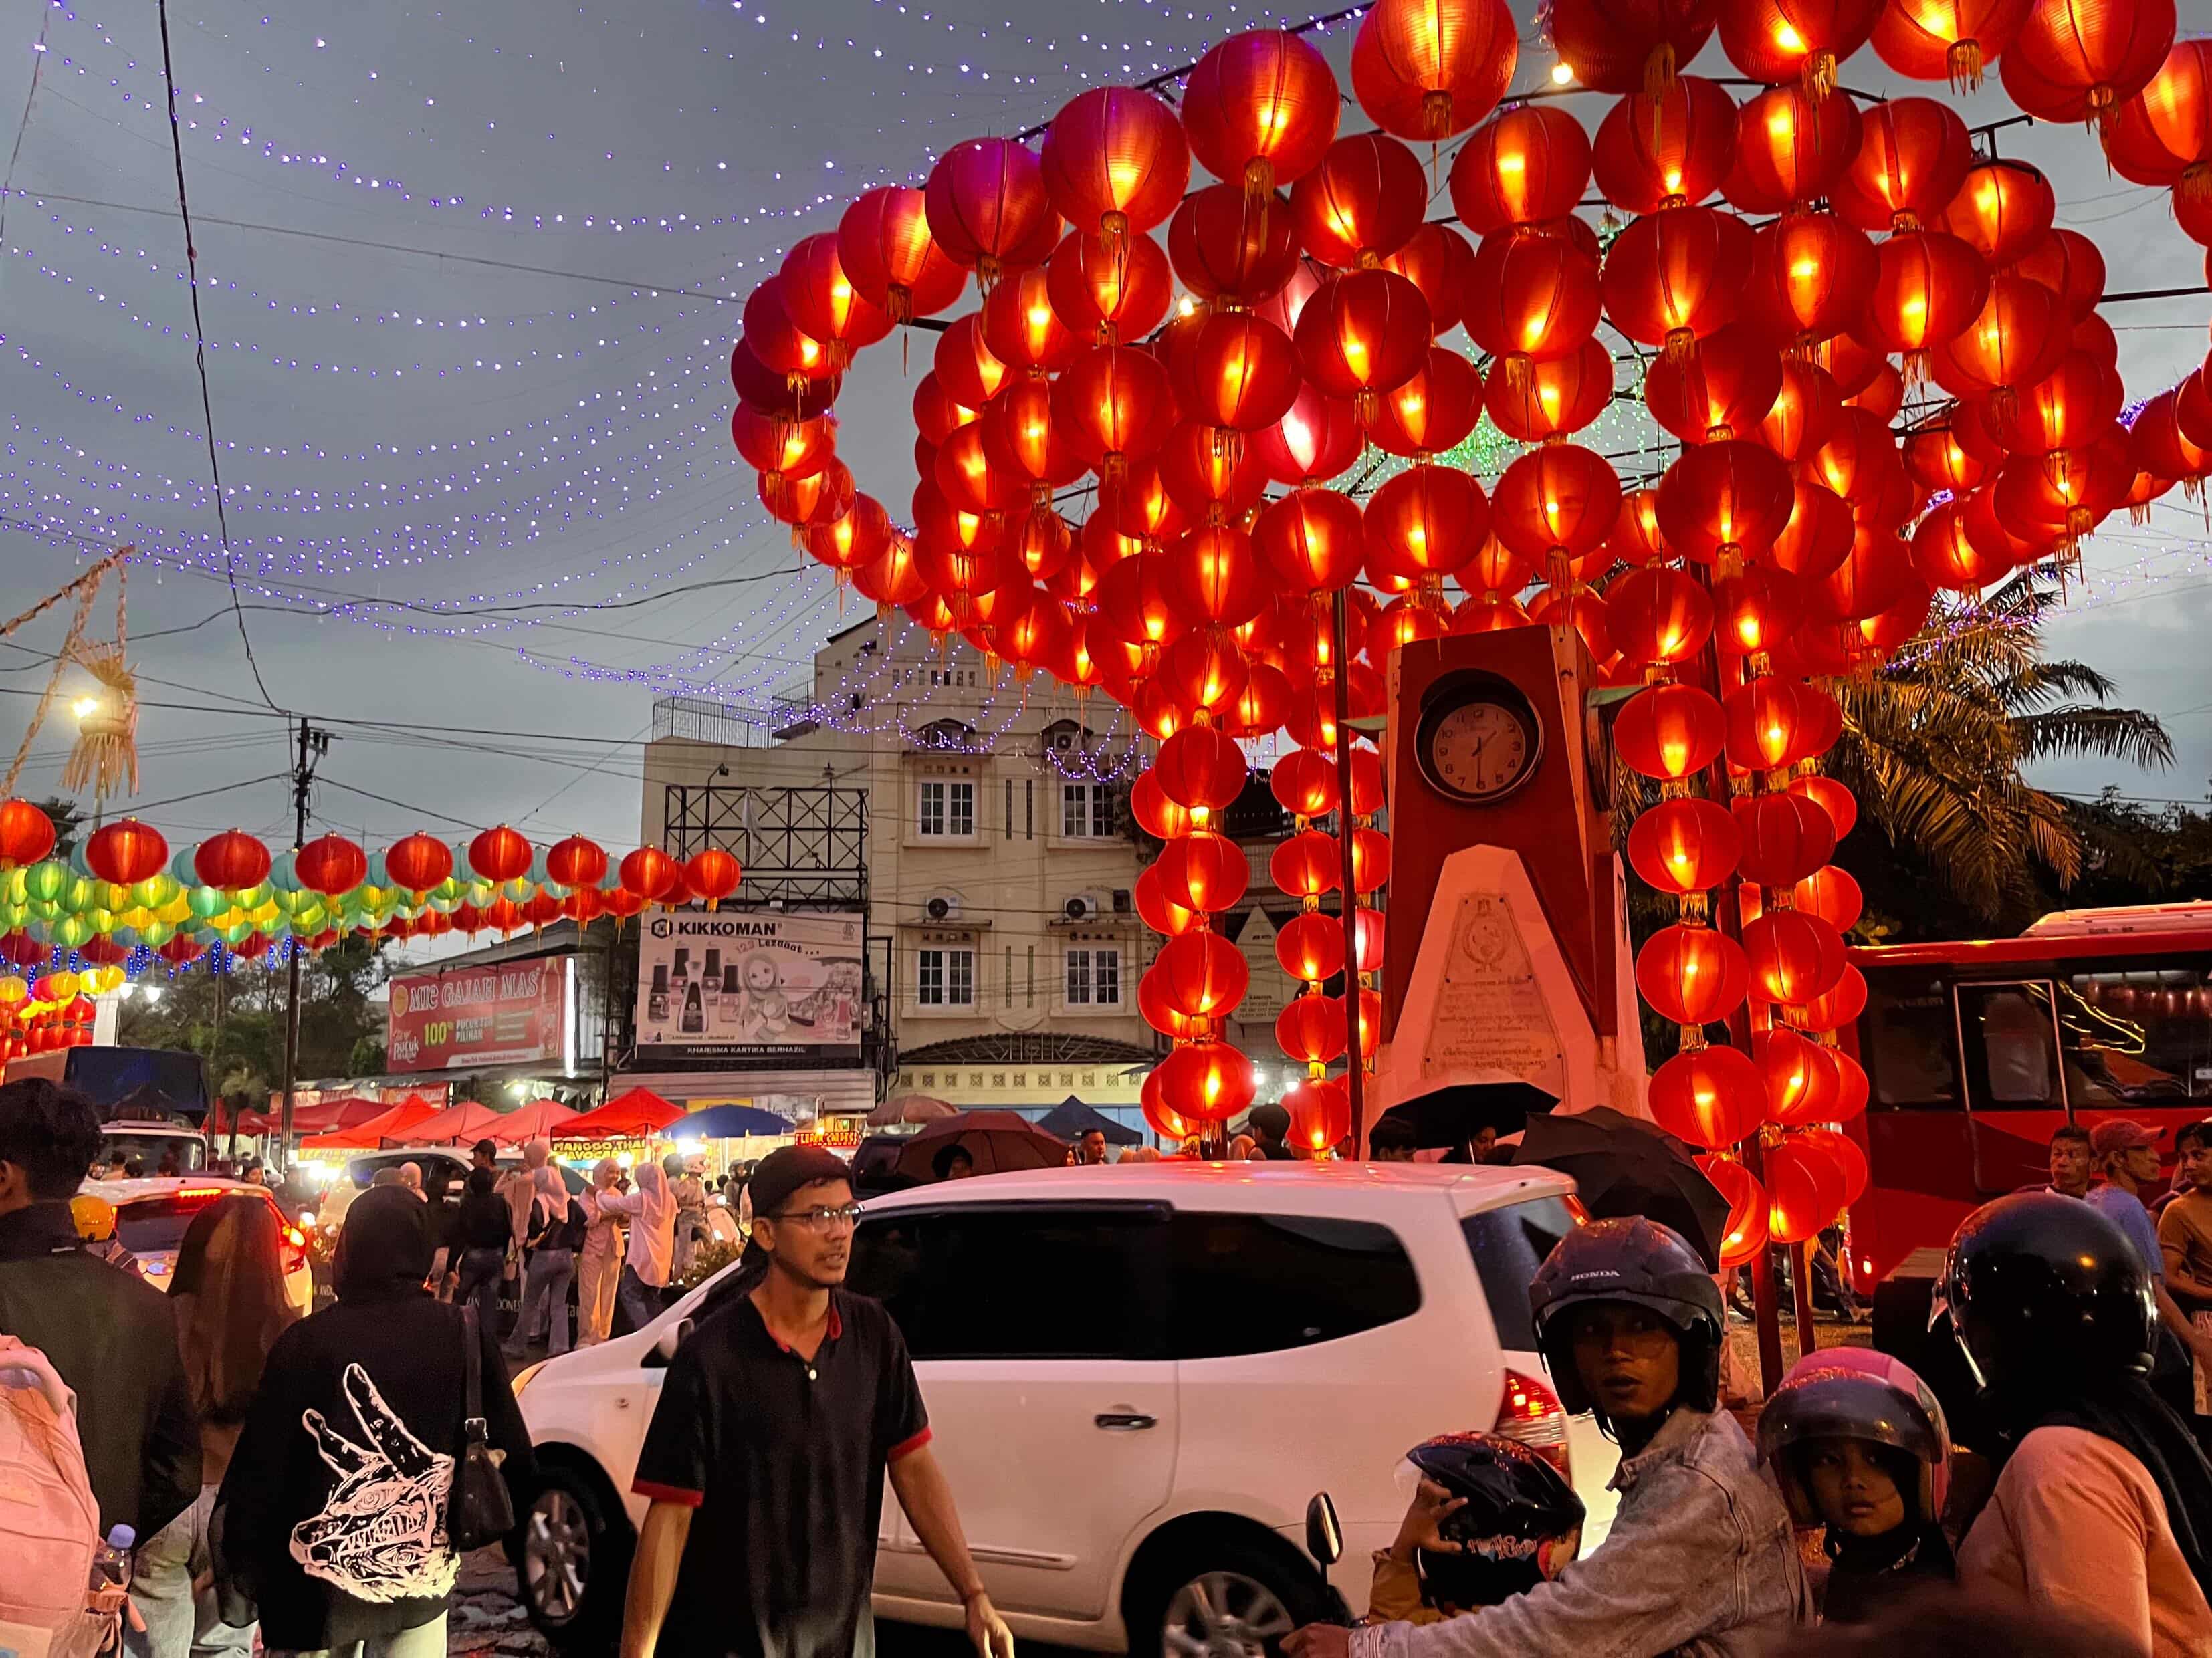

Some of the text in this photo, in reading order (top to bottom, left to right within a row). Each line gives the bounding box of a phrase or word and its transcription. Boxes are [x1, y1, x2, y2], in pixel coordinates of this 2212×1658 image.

[1456, 715, 1464, 723] 11
[1473, 710, 1484, 718] 12
[1508, 723, 1516, 733] 2
[1440, 729, 1453, 738] 10
[1511, 741, 1521, 752] 3
[1439, 747, 1448, 757] 9
[1445, 764, 1454, 774] 8
[1508, 759, 1516, 769] 4
[1458, 777, 1466, 787] 7
[1495, 774, 1504, 784] 5
[679, 922, 776, 936] KIKKOMAN
[500, 973, 538, 1000] MAS
[552, 1138, 646, 1151] MANGGO THAI
[1570, 1270, 1621, 1282] HONDA
